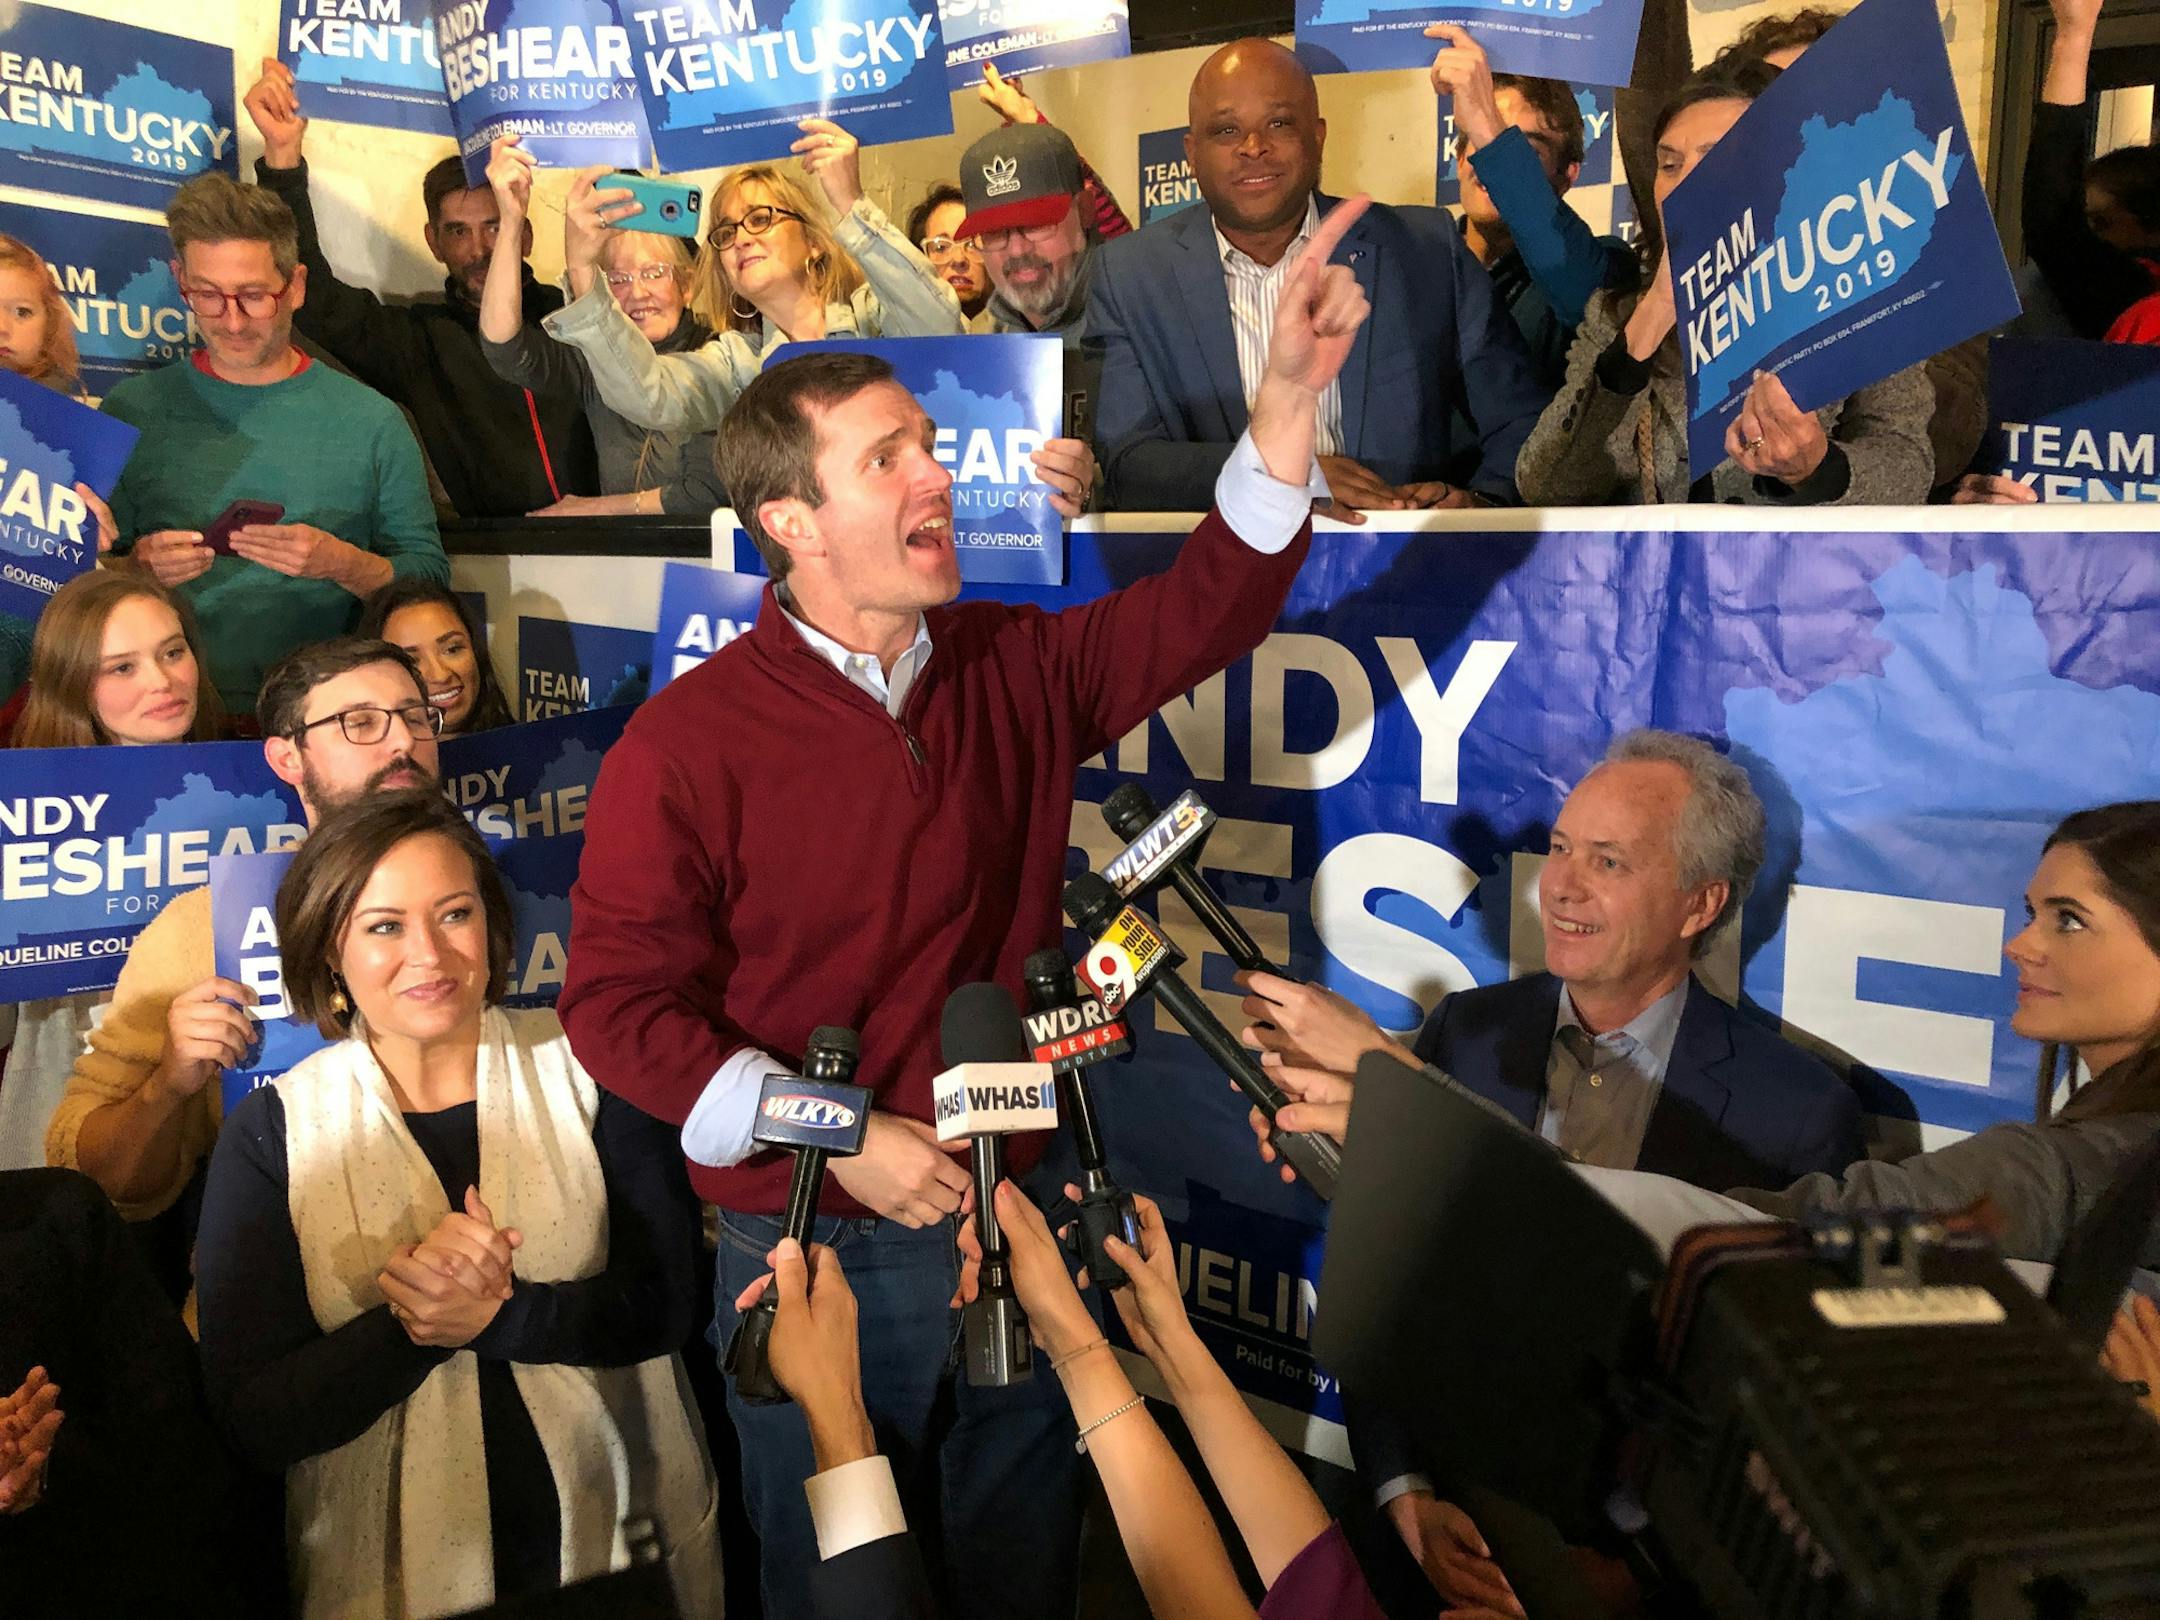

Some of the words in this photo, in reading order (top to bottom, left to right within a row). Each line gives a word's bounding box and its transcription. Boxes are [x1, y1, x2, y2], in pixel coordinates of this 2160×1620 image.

[439, 0, 488, 49] ANDY
[634, 0, 758, 46] TEAM
[644, 13, 933, 97] KENTUCKY
[970, 32, 1037, 58] COLEMAN
[443, 25, 636, 103] BESHEAR
[490, 84, 519, 103] FOR
[528, 82, 638, 101] KENTUCKY
[822, 68, 888, 94] 2019
[567, 120, 637, 136] GOVERNOR
[131, 146, 188, 171] 2019
[1679, 207, 1757, 312] TEAM
[1687, 126, 1954, 377] KENTUCKY
[1813, 249, 1897, 313] 2019
[2001, 421, 2155, 475] TEAM
[951, 489, 1047, 509] NTUCKY
[969, 531, 1043, 547] GOVERNOR
[525, 668, 590, 703] TEAM
[106, 894, 160, 915] FOR
[1118, 912, 1137, 932] ON
[1120, 923, 1147, 953] YOUR
[1134, 934, 1158, 961] SIDE
[0, 942, 83, 966] UELINE
[1135, 945, 1167, 982] wcpo.com
[1104, 985, 1121, 1005] abc
[1051, 1028, 1112, 1058] NEWS
[1061, 1047, 1109, 1070] HDTV
[764, 1096, 841, 1125] WLKY
[1236, 1343, 1273, 1372] Paid
[1278, 1358, 1303, 1380] for
[1308, 1368, 1329, 1394] by
